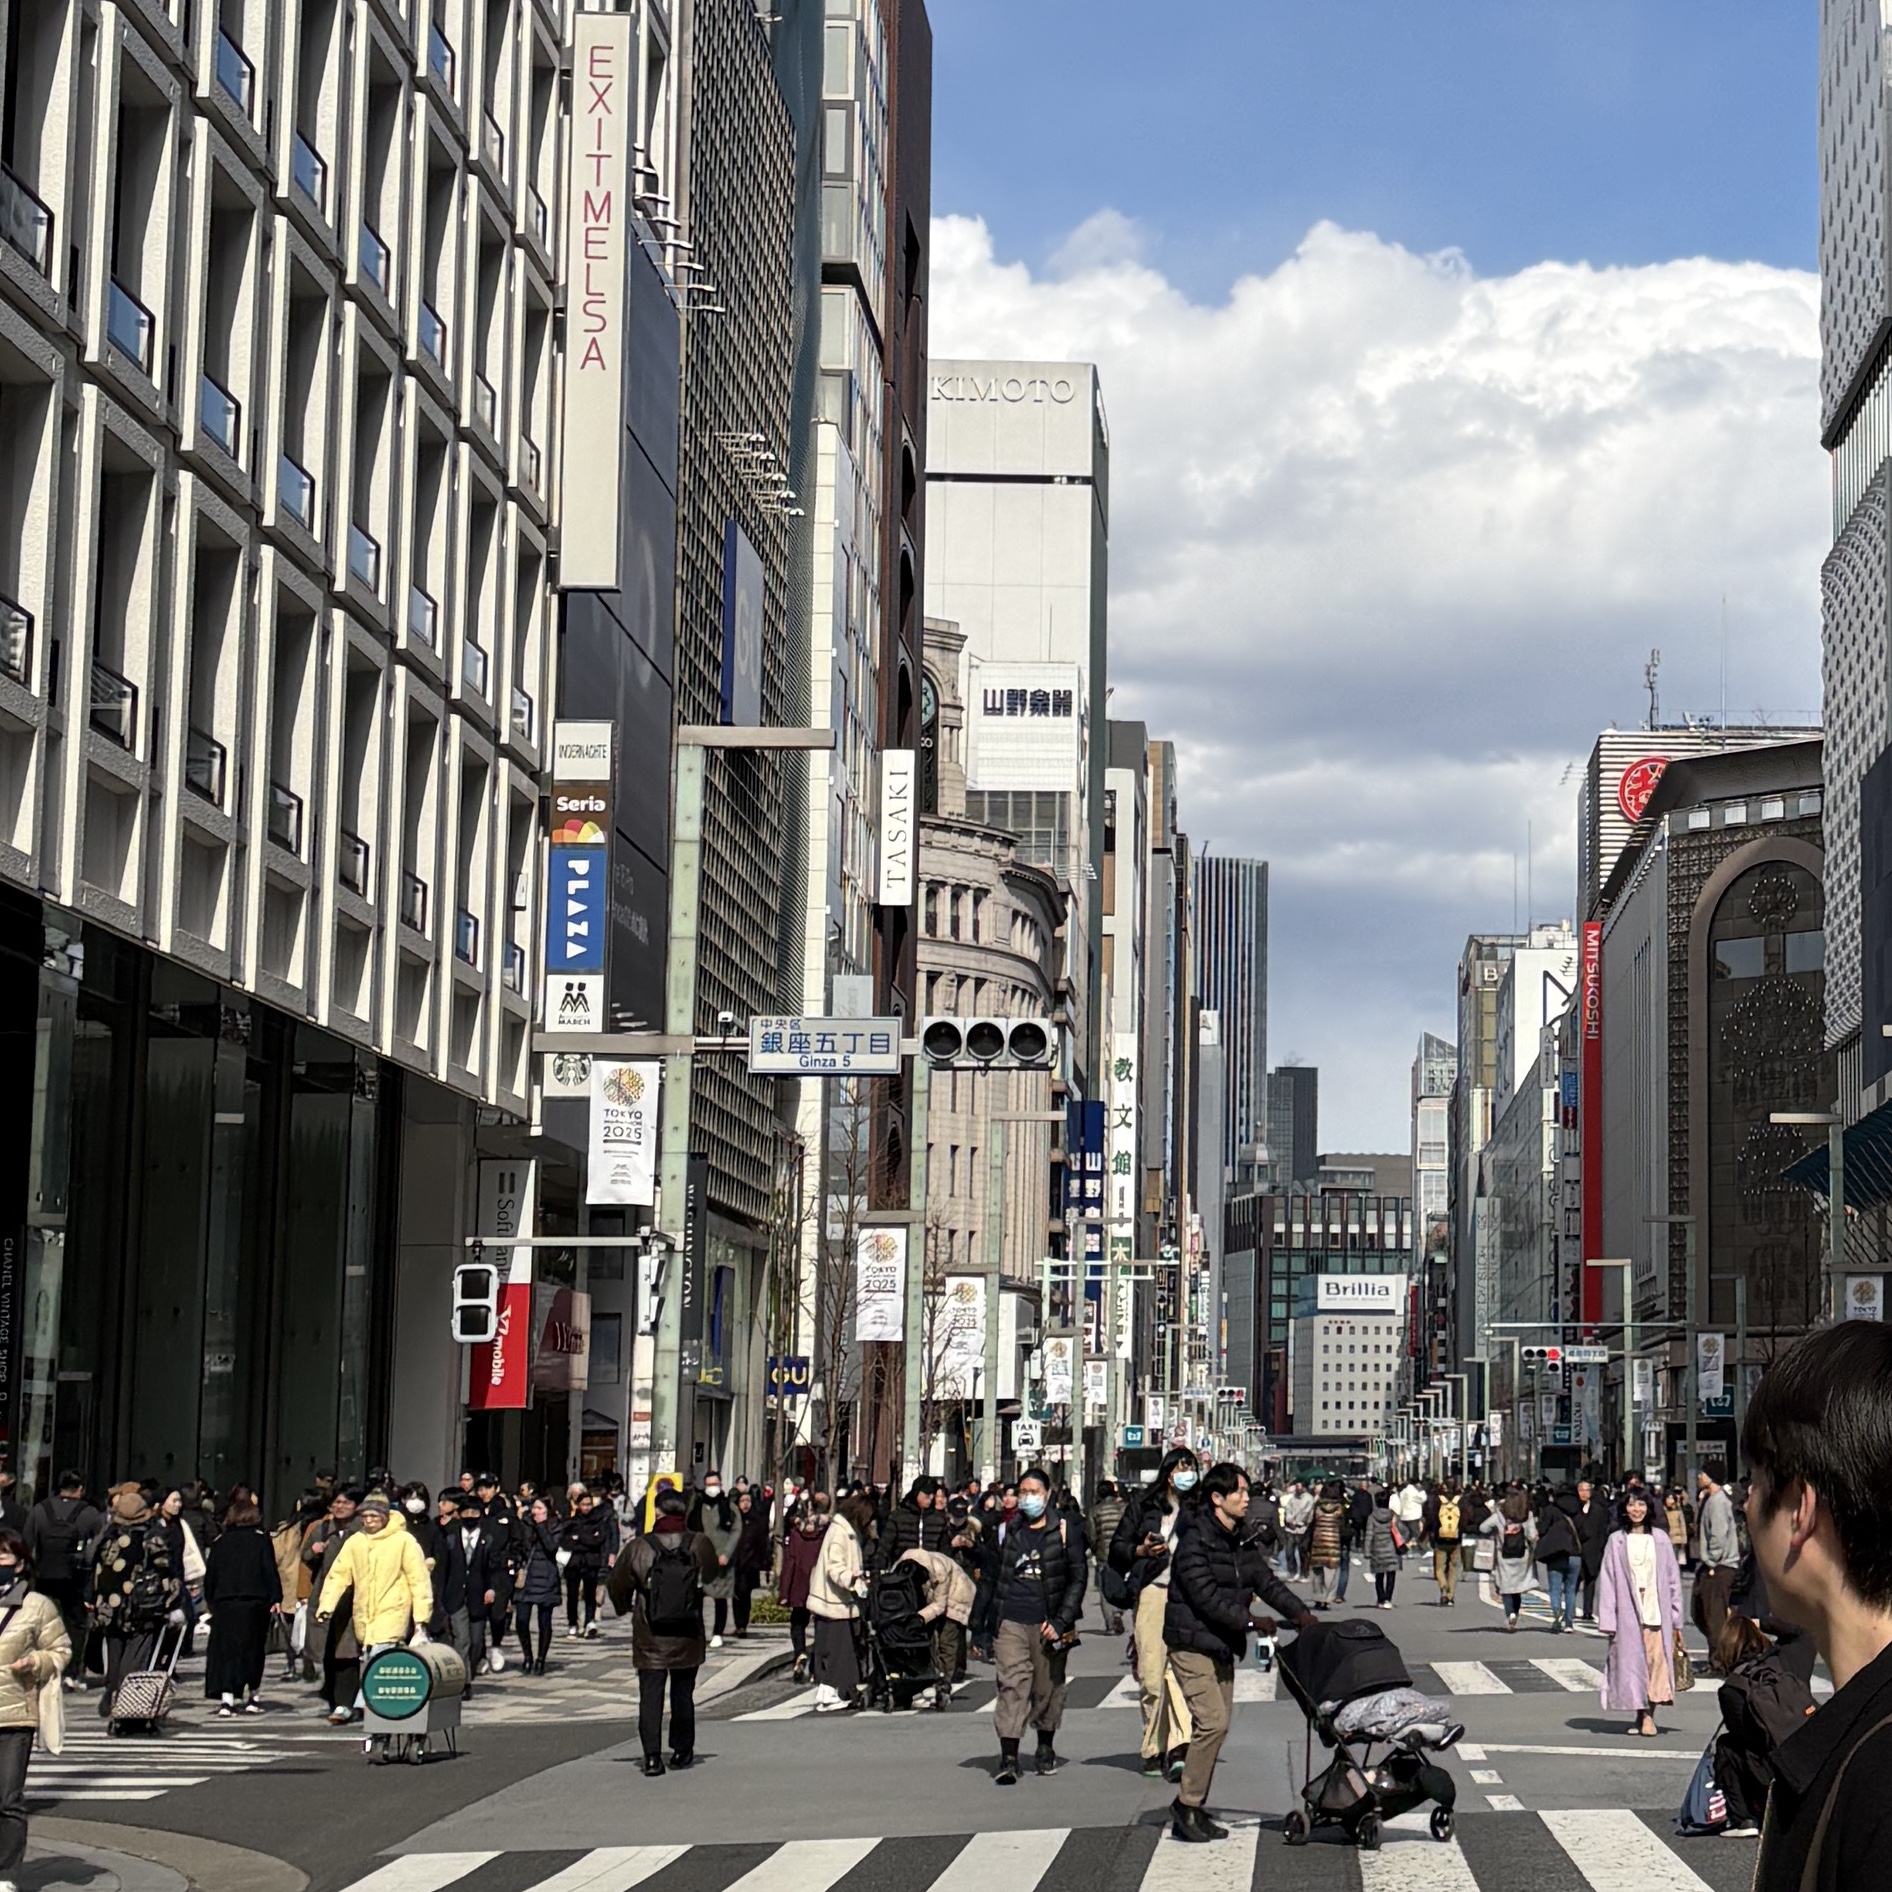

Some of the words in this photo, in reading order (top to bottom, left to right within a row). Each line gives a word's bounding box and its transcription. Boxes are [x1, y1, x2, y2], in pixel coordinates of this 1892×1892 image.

[580, 45, 614, 371] EXITMELSA
[983, 688, 1073, 718] 山野楽器
[556, 796, 606, 812] Seria
[887, 770, 908, 889] TASAKI
[566, 859, 590, 959] PLAZA
[1586, 929, 1600, 1040] MITSUKOSHI
[760, 1031, 890, 1055] 銀座五丁目
[799, 1055, 837, 1067] Ginza
[842, 1055, 851, 1067] 5
[603, 1108, 643, 1120] TOKYO
[603, 1126, 642, 1139] 2025
[496, 1198, 515, 1284] Softank
[1325, 1282, 1390, 1296] Brillia
